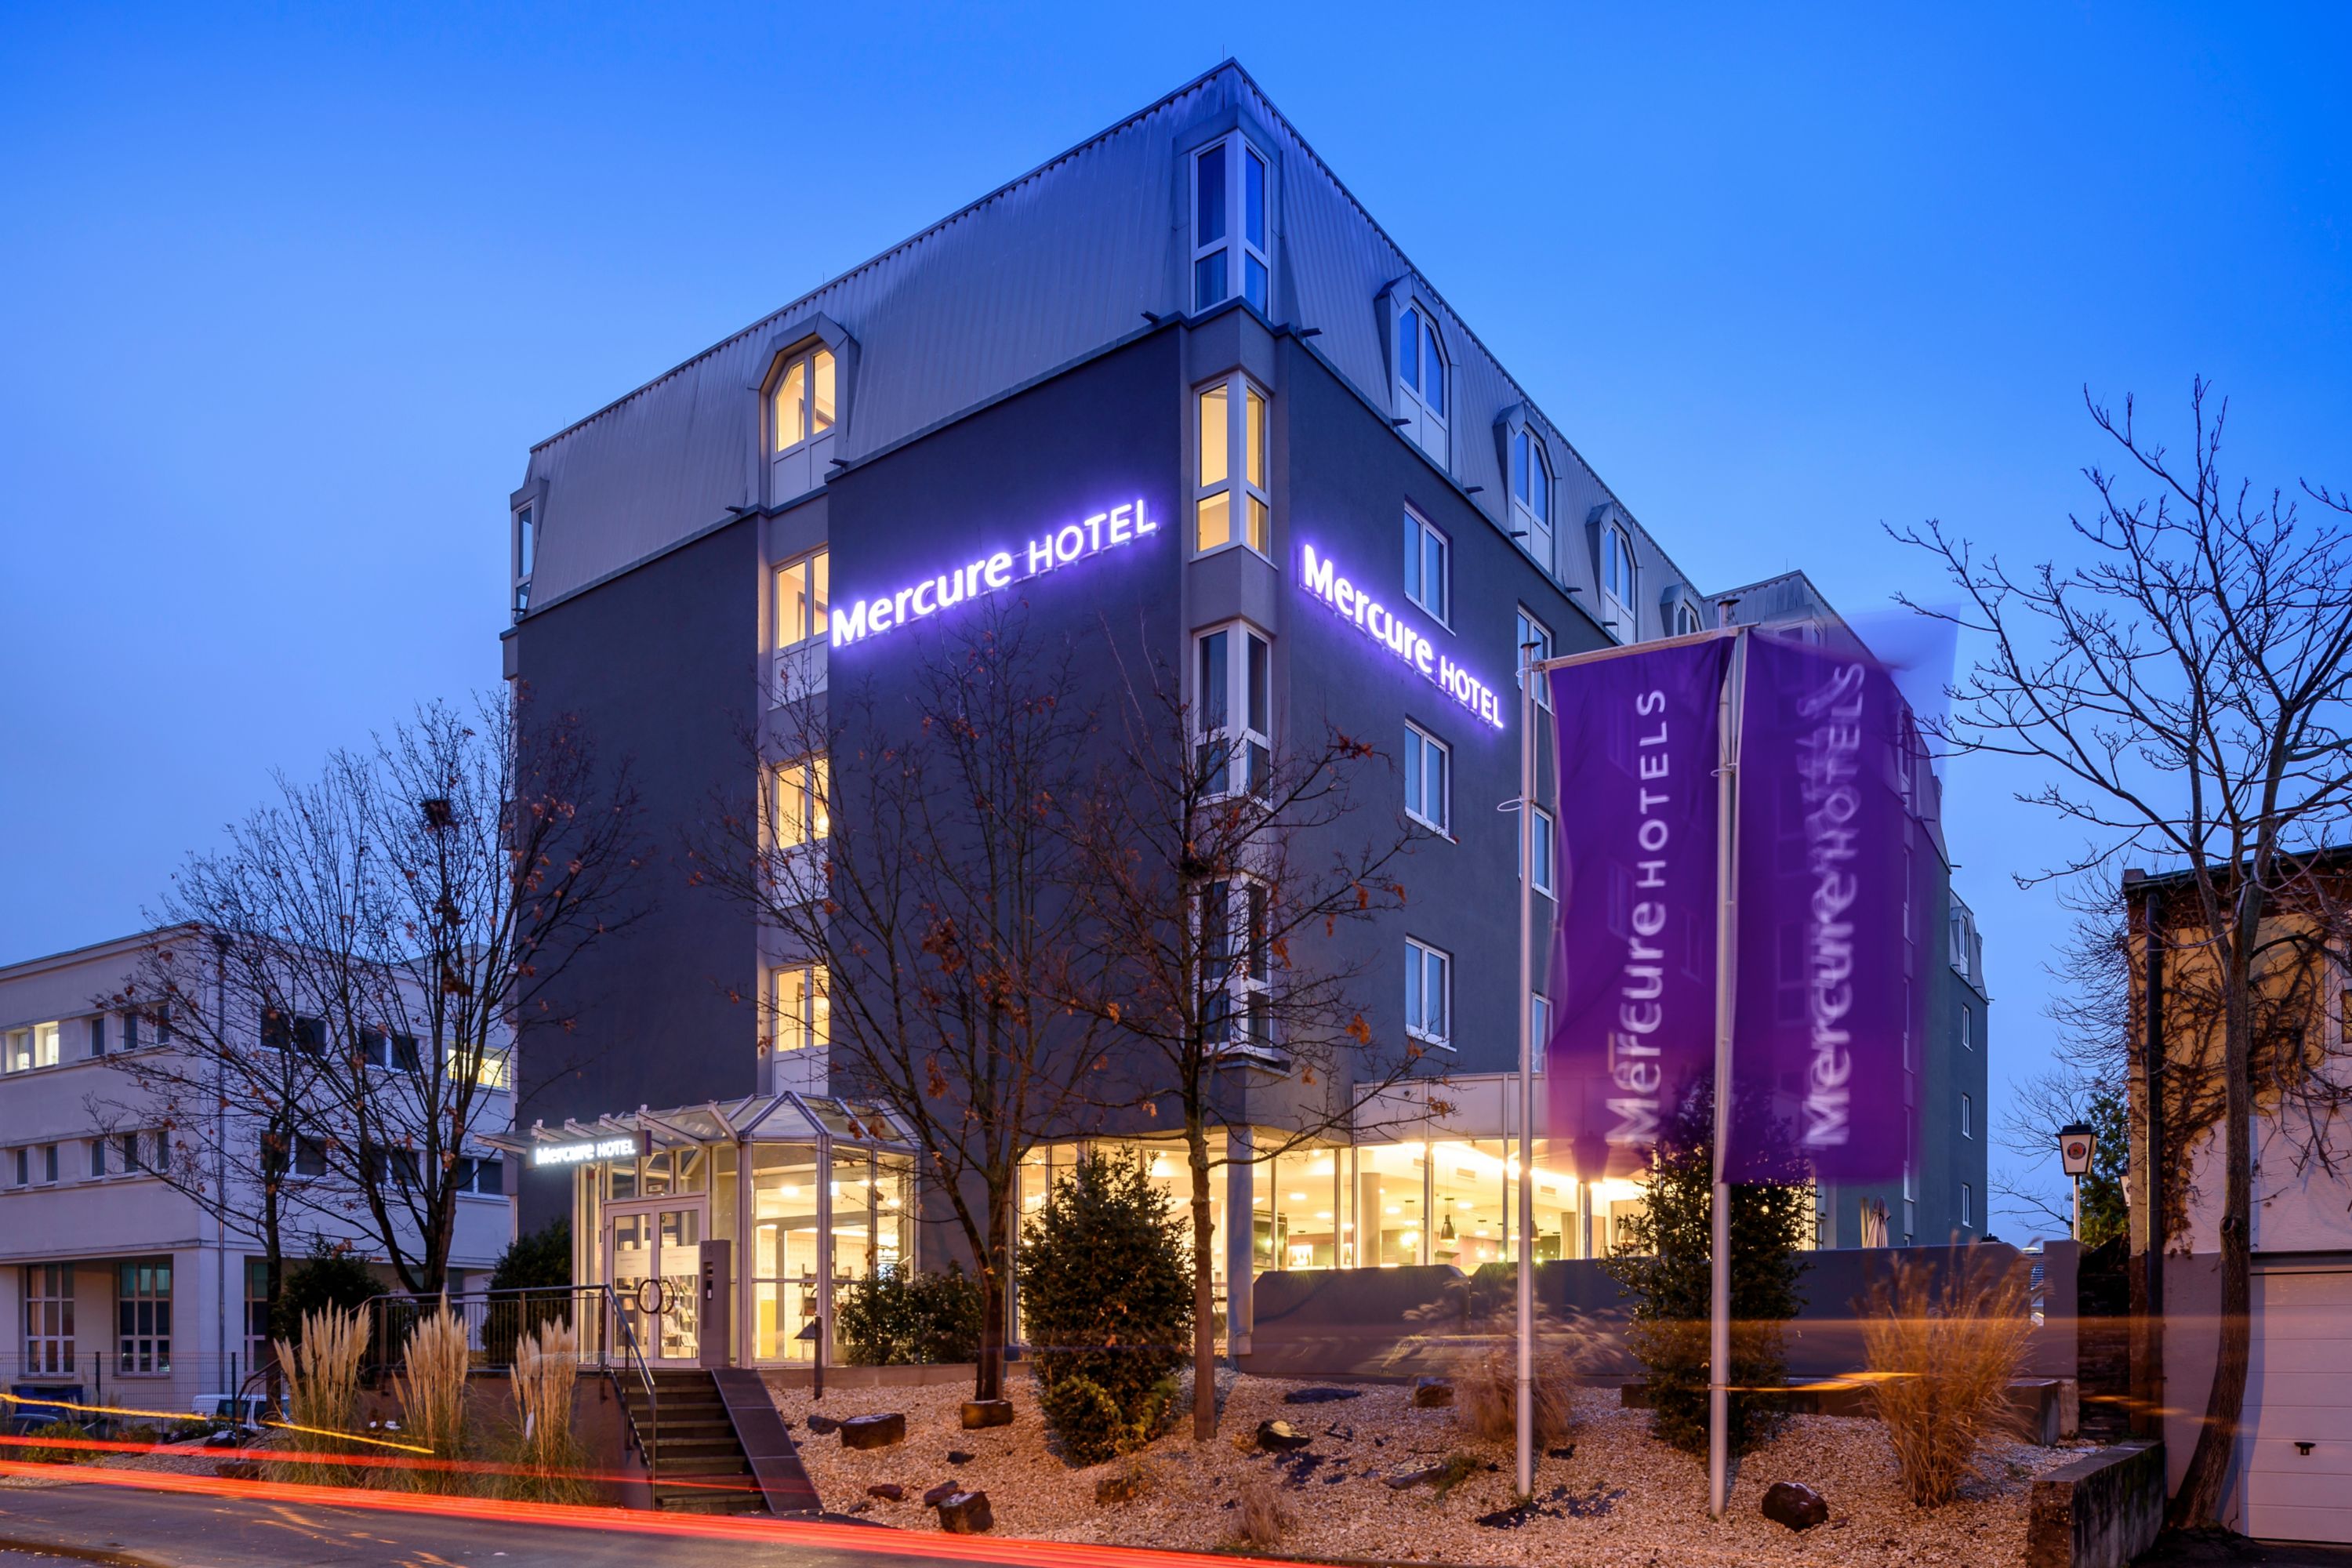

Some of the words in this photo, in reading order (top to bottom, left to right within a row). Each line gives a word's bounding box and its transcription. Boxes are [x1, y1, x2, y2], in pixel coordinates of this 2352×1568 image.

[831, 550, 1014, 648] Mercure
[1029, 498, 1157, 575] HOTEL
[1303, 543, 1434, 674] Mercure
[1439, 654, 1504, 729] HOTEL
[1635, 689, 1671, 889] HOTELS
[1605, 901, 1667, 1148] Mercure
[1802, 870, 1858, 1148] Mercure
[535, 1144, 595, 1166] Mercure
[597, 1139, 637, 1158] HOTEL
